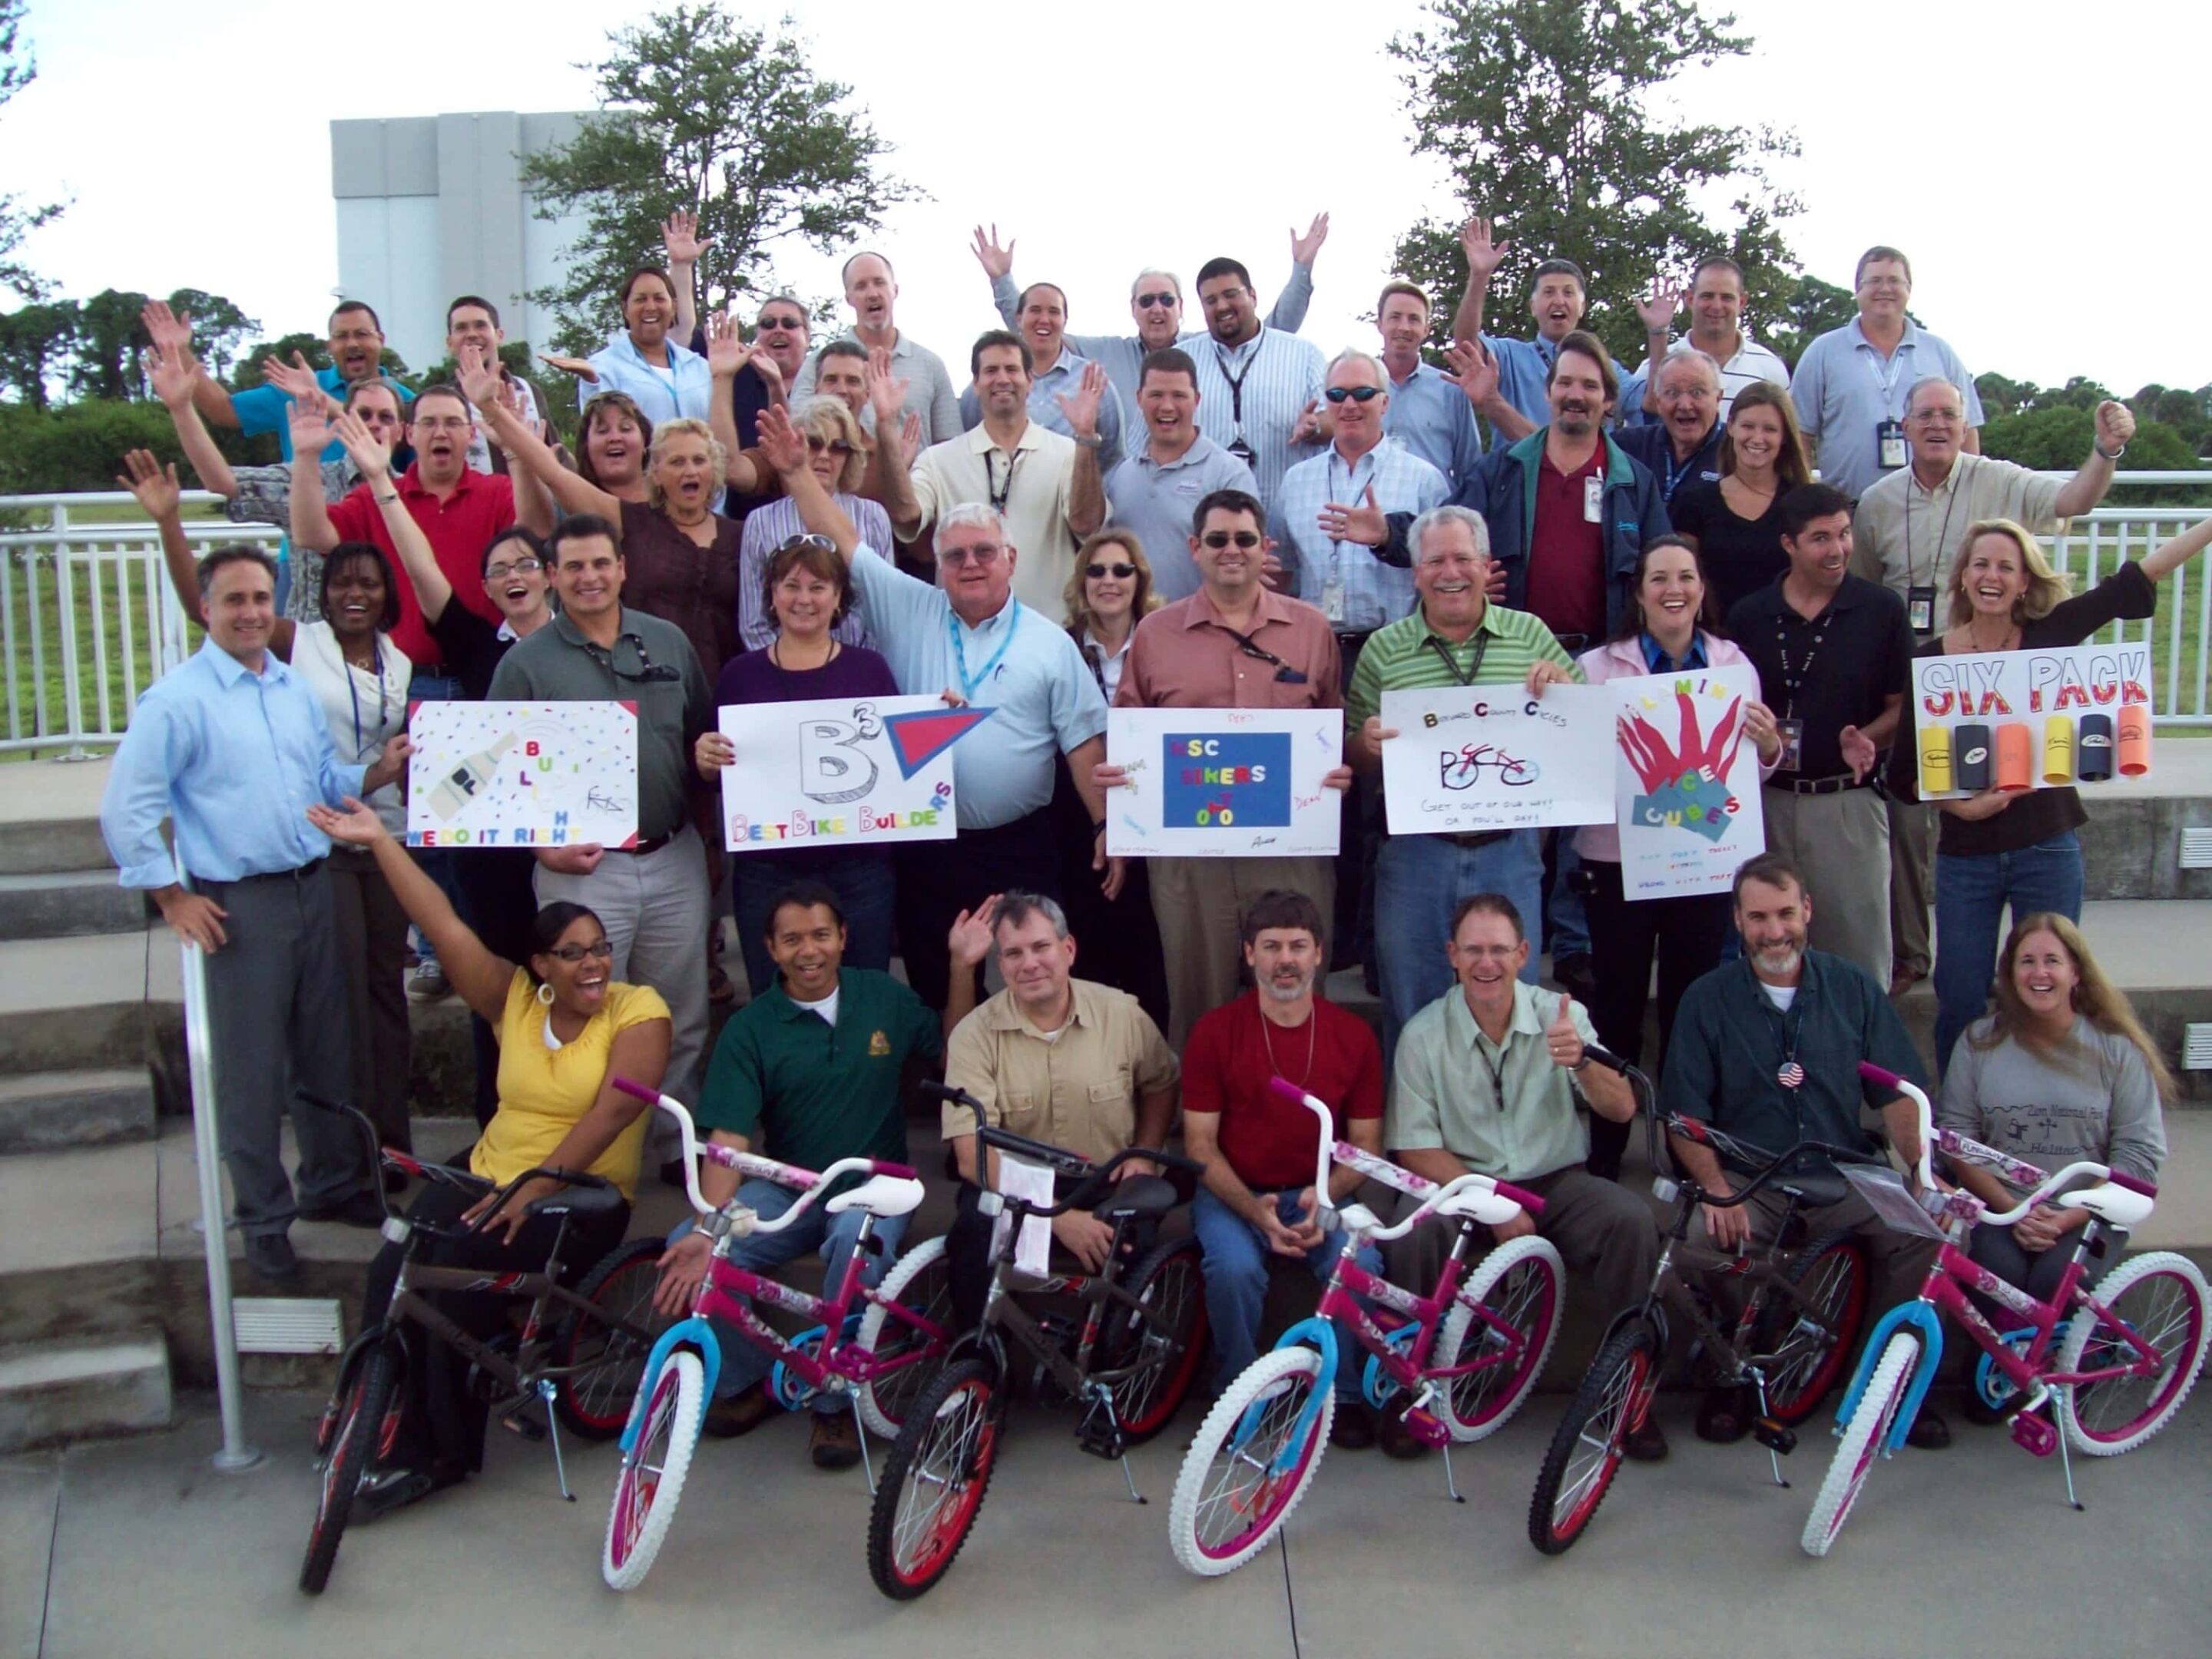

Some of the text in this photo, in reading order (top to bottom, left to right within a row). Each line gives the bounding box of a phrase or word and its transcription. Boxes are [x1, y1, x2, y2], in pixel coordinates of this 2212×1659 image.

[1922, 651, 2148, 716] SIX PACK
[731, 782, 952, 843] BEST BIKE BUILDERS
[1422, 800, 1451, 813] GET
[1461, 802, 1482, 811] OUT
[1645, 796, 1740, 826] CUBES
[408, 827, 581, 846] WE DO IT RIGHT
